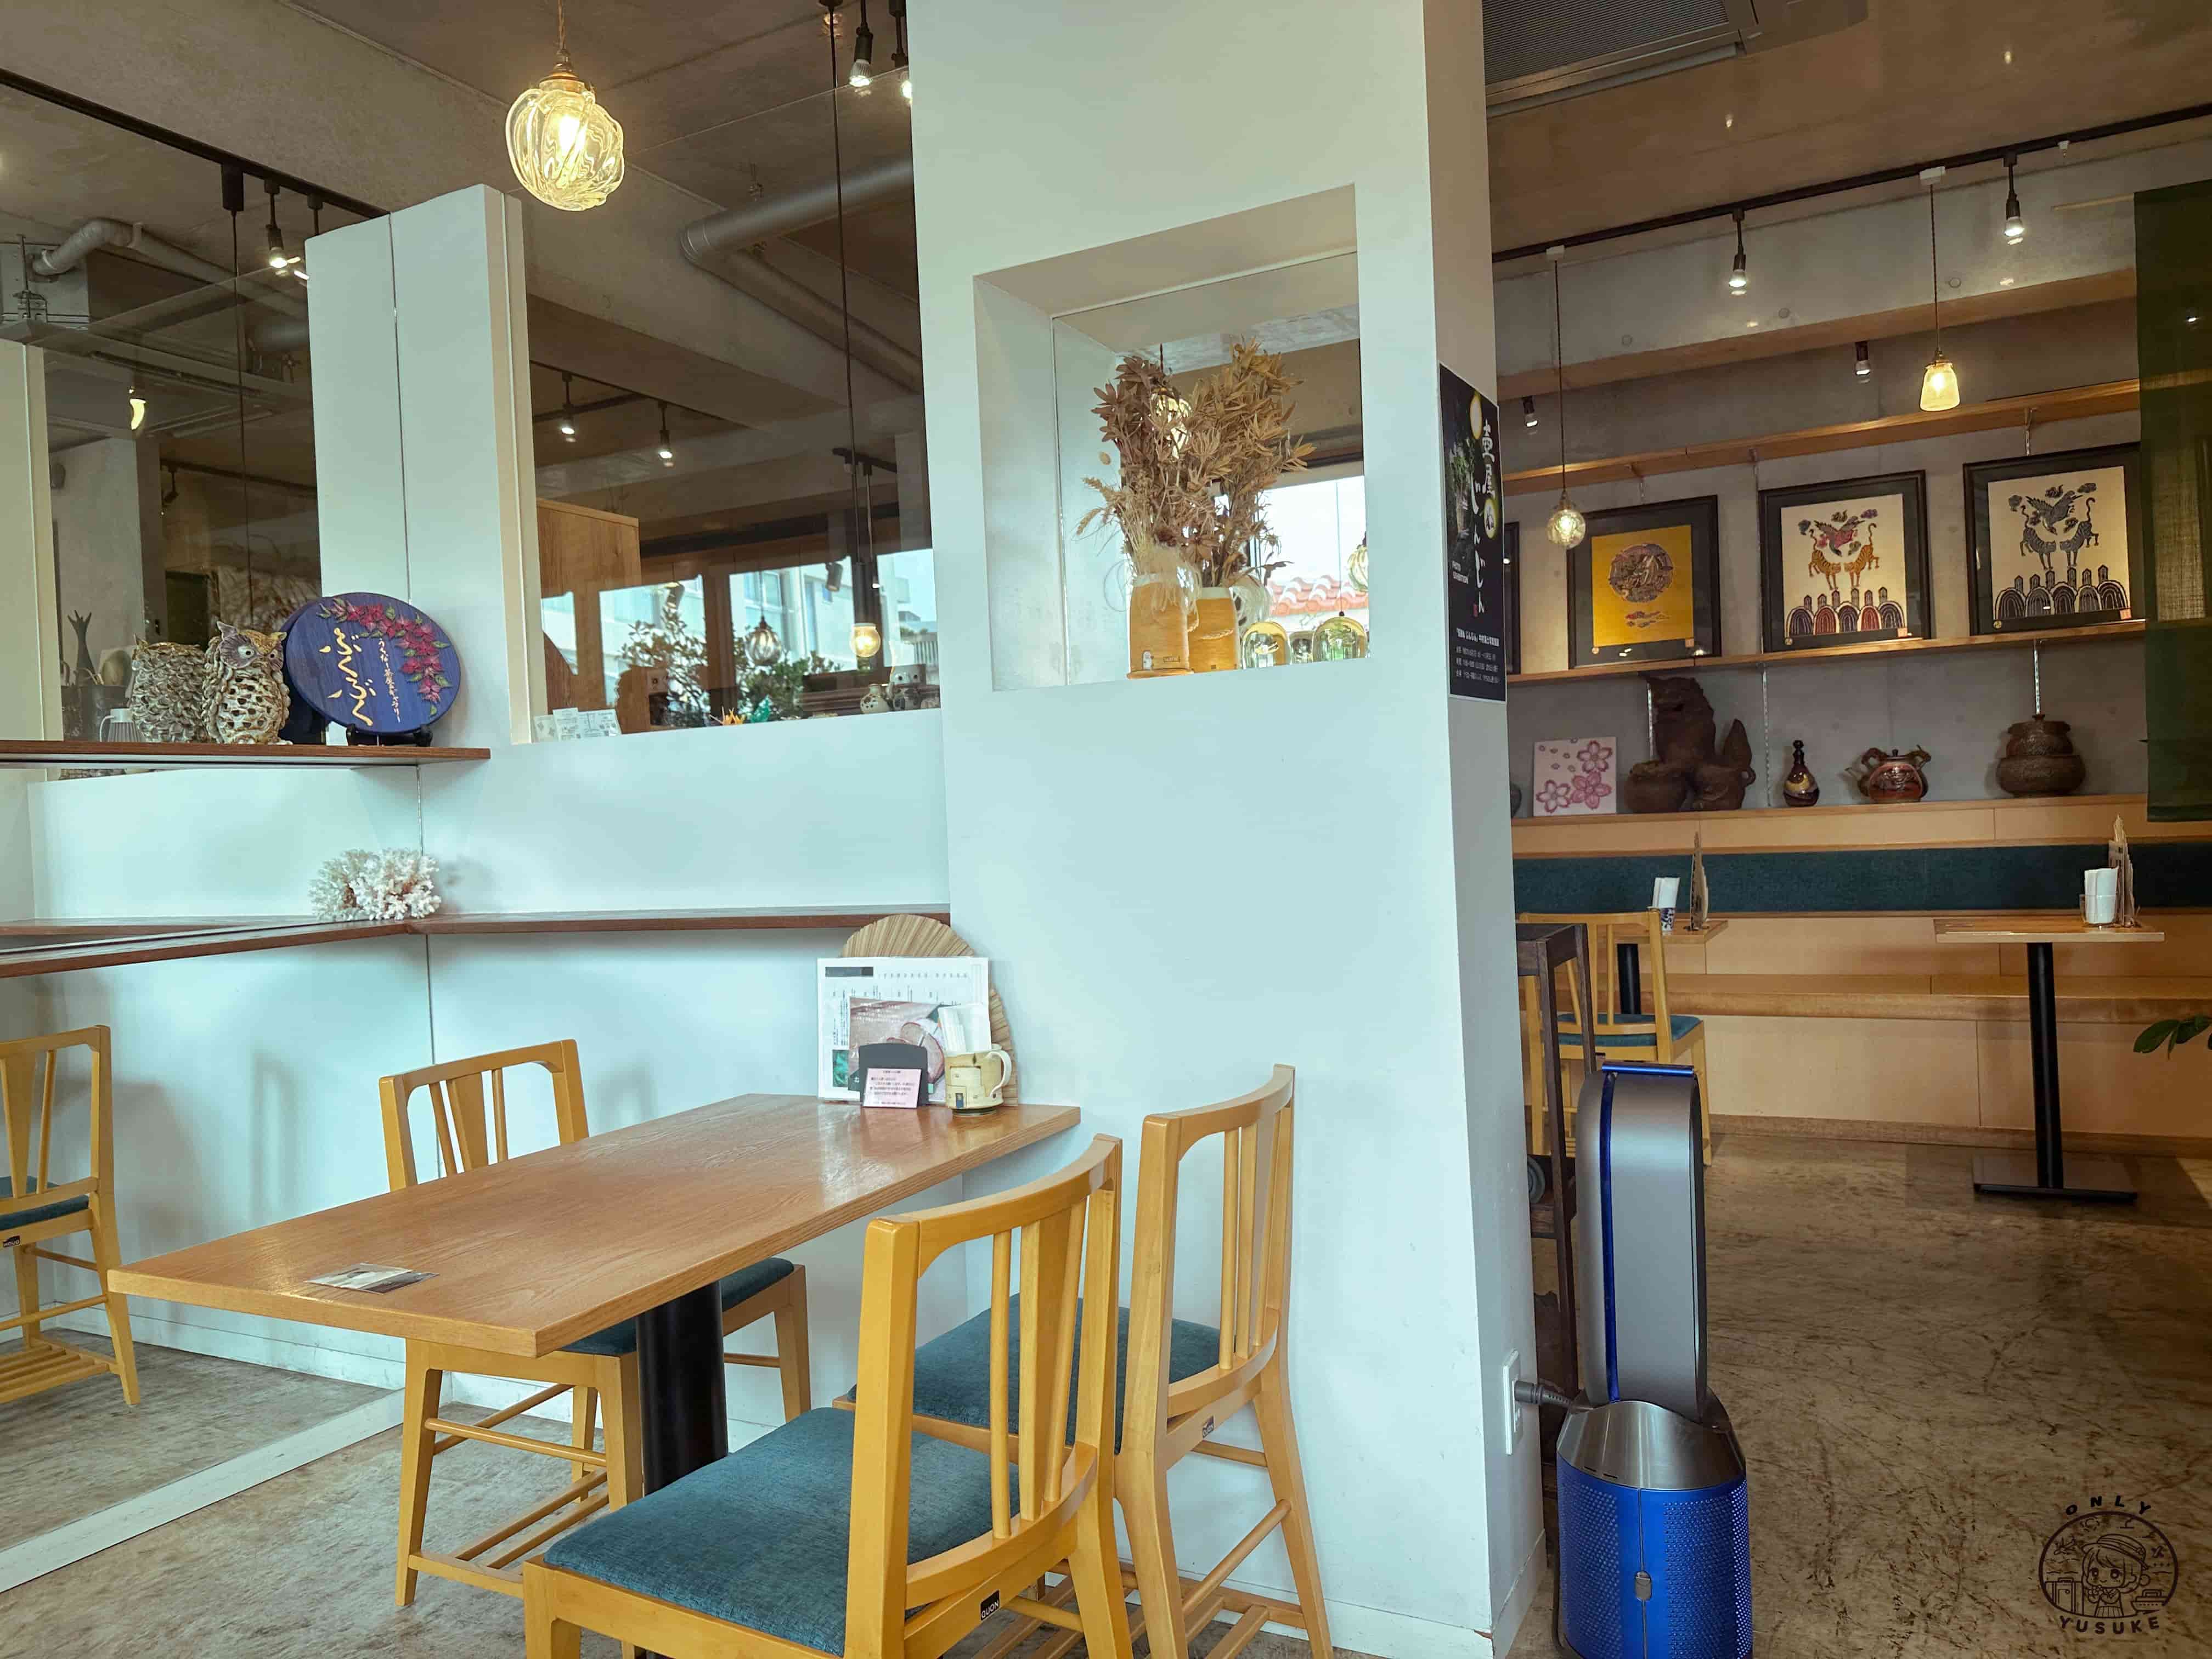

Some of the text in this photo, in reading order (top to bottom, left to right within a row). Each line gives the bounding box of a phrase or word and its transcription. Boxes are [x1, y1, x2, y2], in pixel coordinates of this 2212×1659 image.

[319, 628, 376, 726] ぶくぶく
[981, 1600, 998, 1618] QUON
